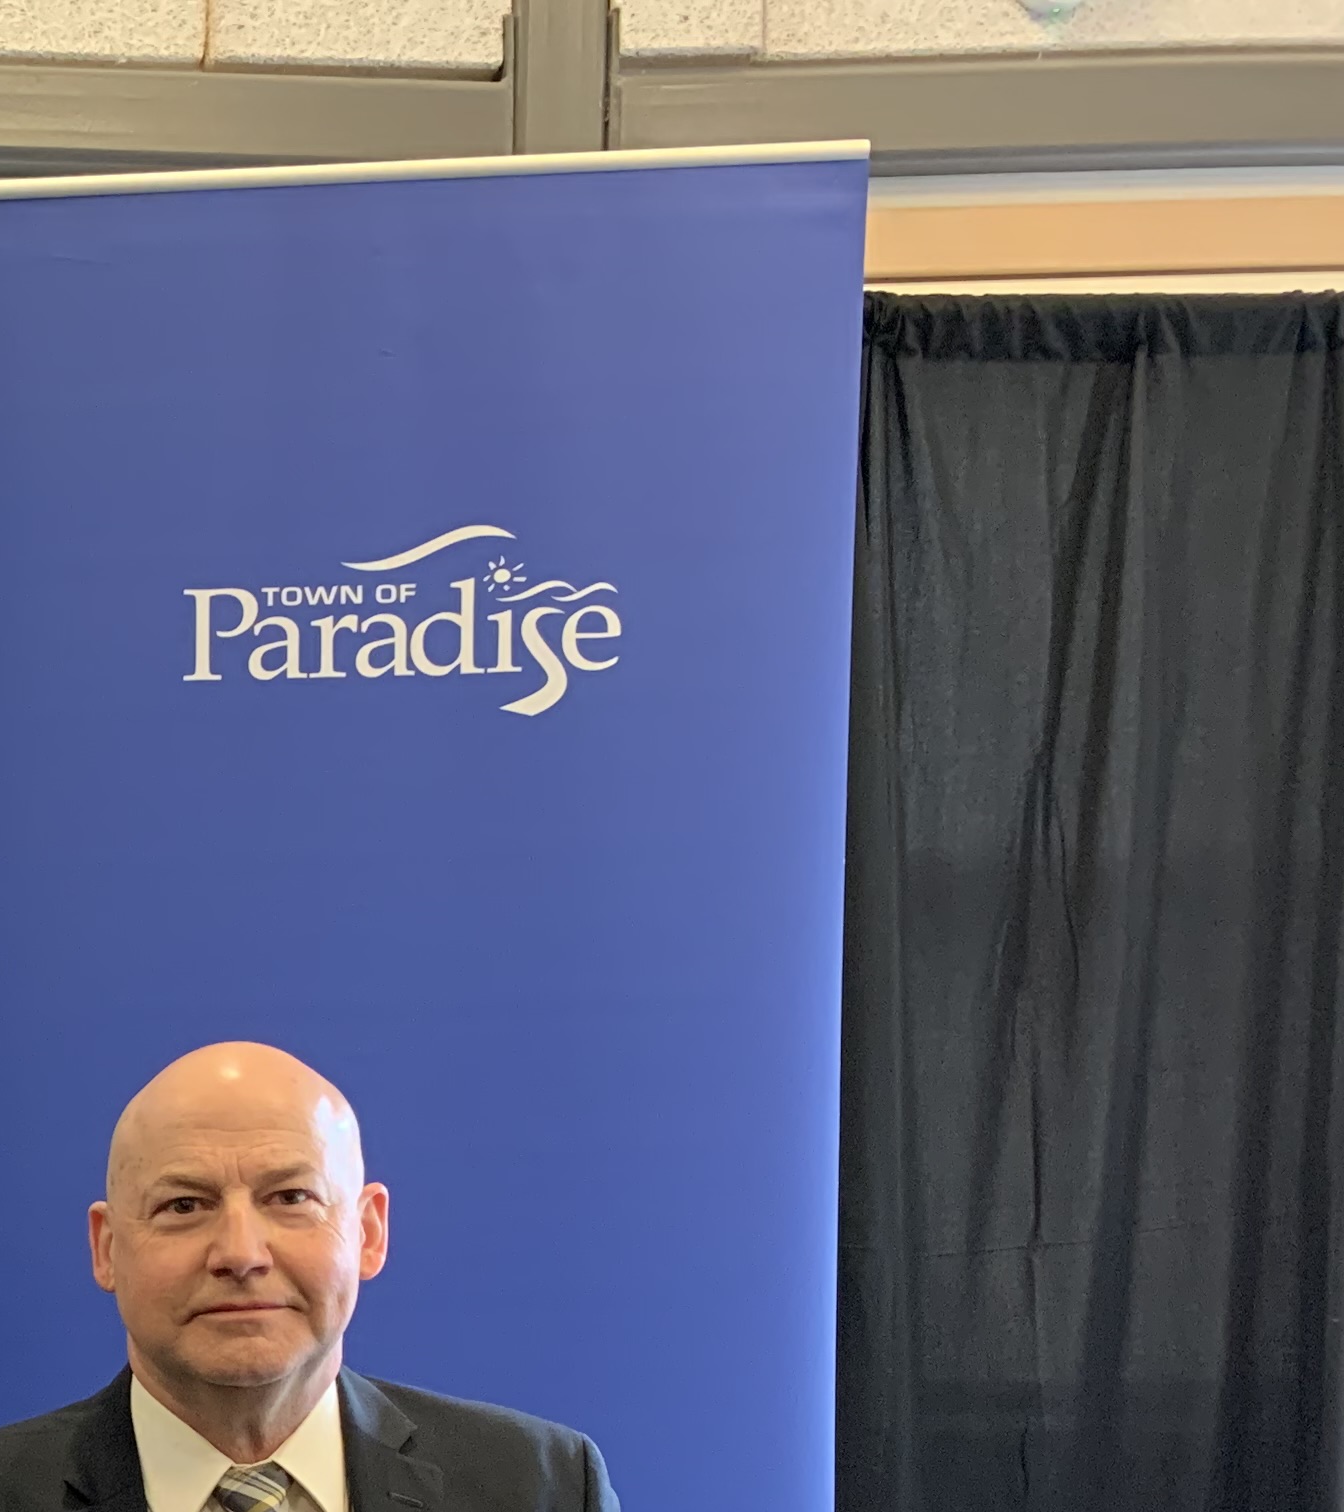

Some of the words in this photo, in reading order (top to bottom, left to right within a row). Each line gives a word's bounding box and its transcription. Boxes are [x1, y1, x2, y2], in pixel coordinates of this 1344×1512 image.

[261, 584, 363, 607] TOWN
[375, 583, 417, 604] OF
[183, 578, 622, 716] Paradise
